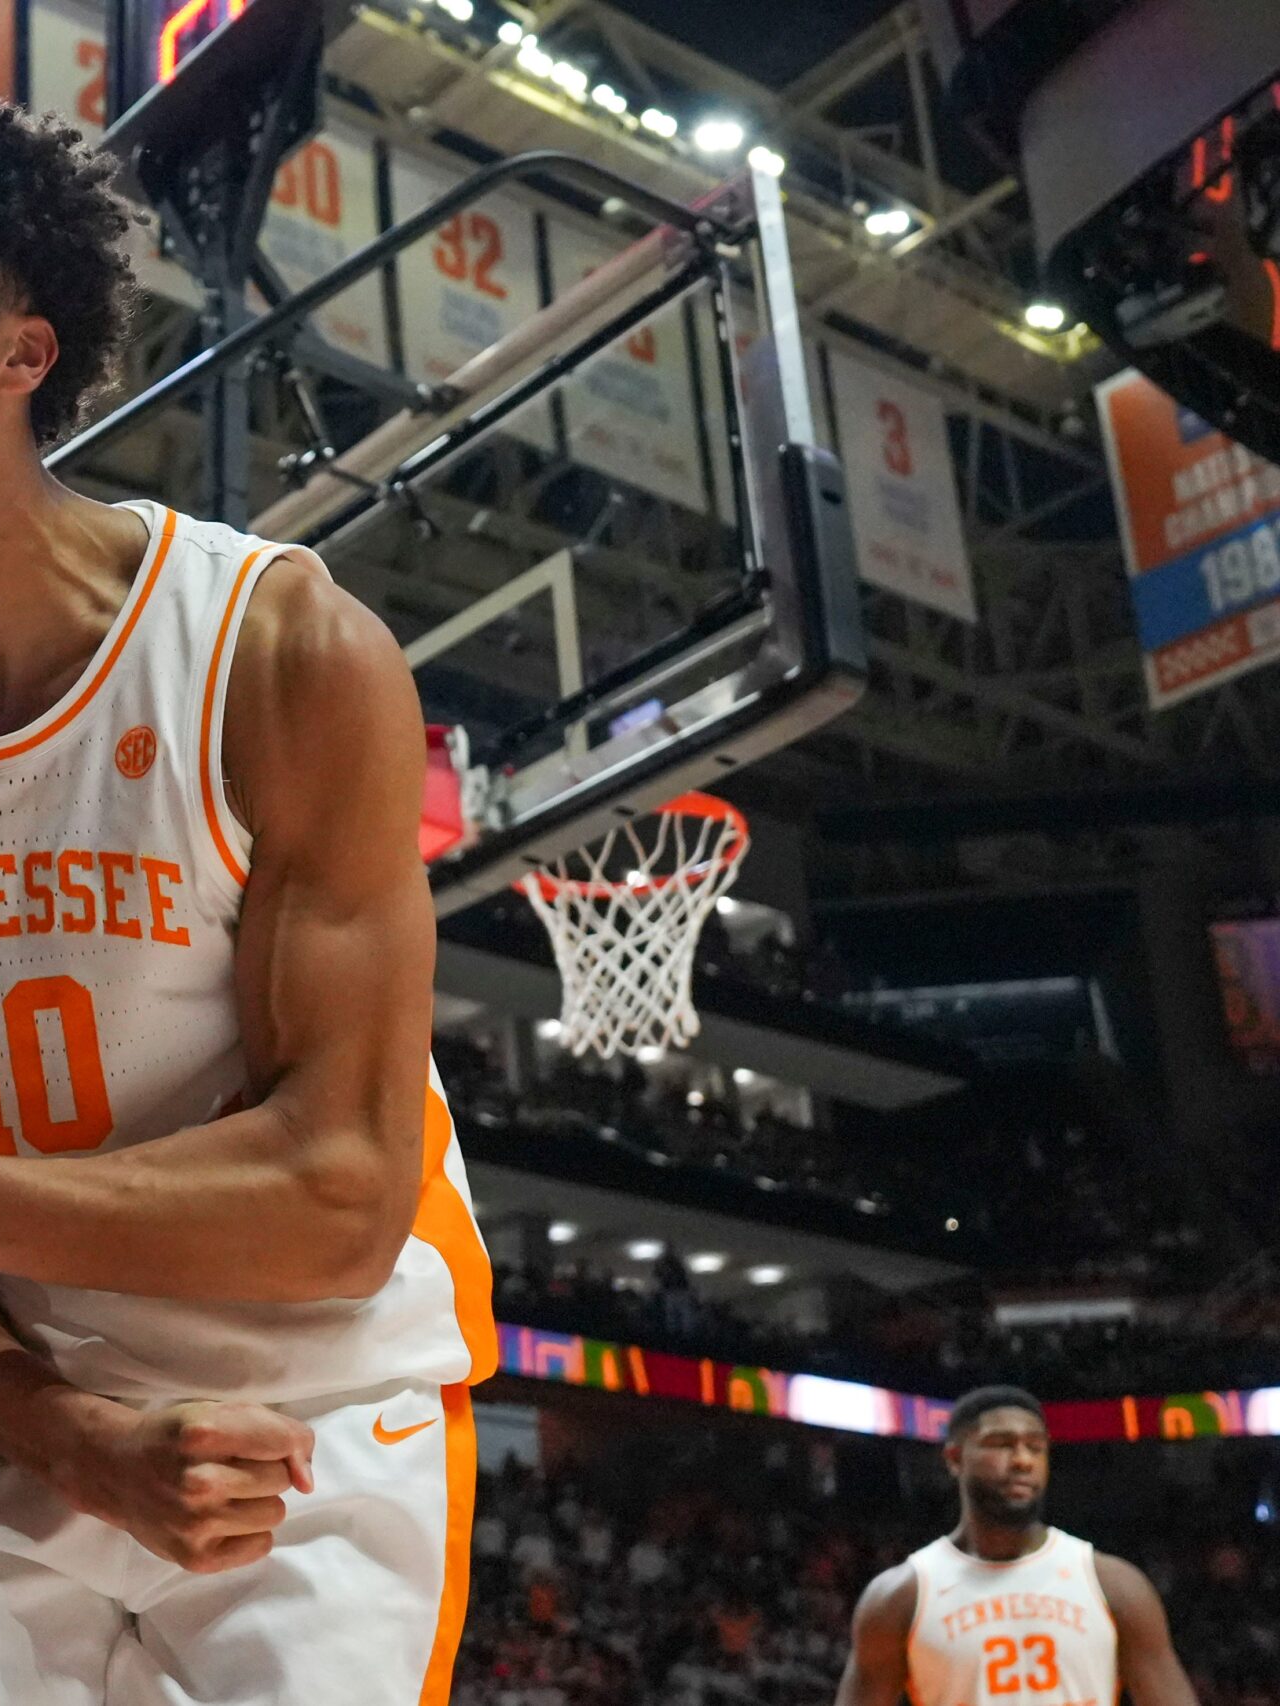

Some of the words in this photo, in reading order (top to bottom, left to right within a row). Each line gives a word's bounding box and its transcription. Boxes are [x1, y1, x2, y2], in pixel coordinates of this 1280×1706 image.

[876, 398, 913, 477] 3
[117, 732, 155, 772] SEC
[942, 1591, 1088, 1643] TENNESSEE
[983, 1632, 1060, 1696] 23
